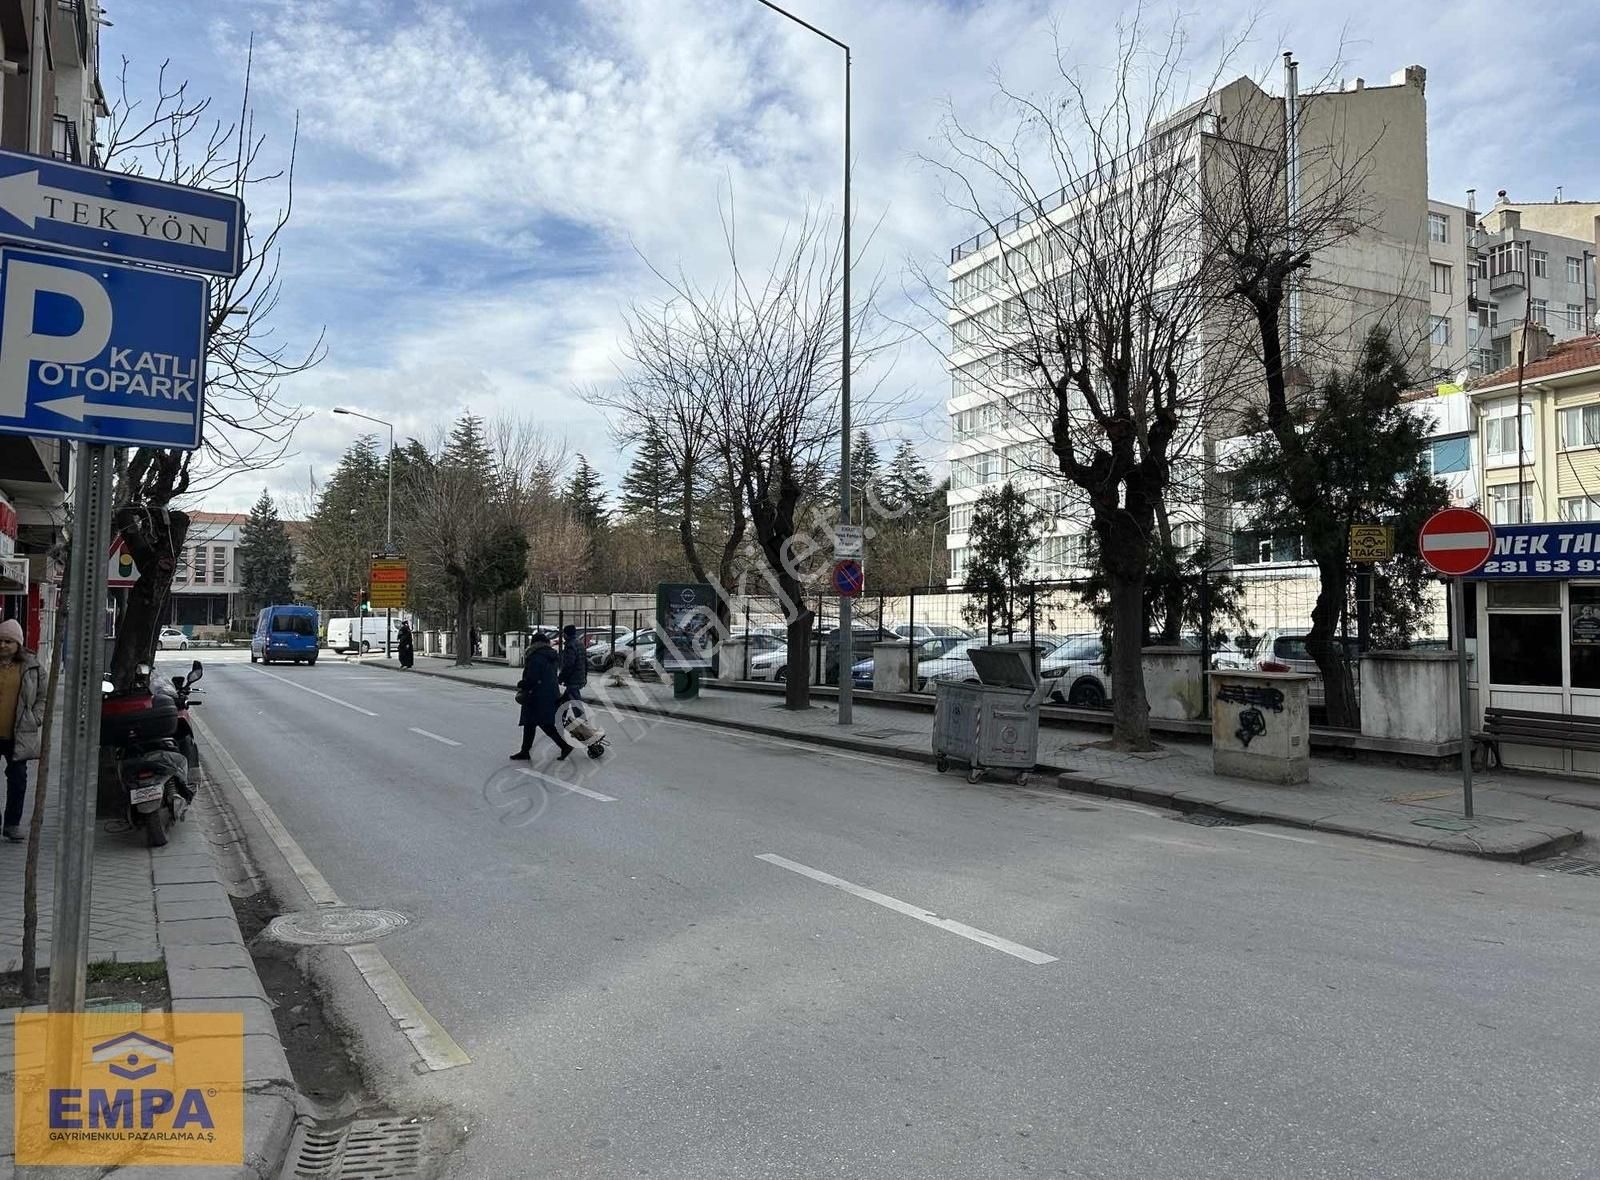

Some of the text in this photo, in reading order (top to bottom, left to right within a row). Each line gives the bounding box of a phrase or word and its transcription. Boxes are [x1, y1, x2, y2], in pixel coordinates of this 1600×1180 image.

[43, 196, 210, 246] TEK YÖN
[0, 258, 113, 419] P
[110, 346, 197, 380] KATLI
[38, 362, 195, 402] OTOPARK
[1493, 534, 1550, 555] NEK
[1483, 559, 1600, 573] 231 53 9
